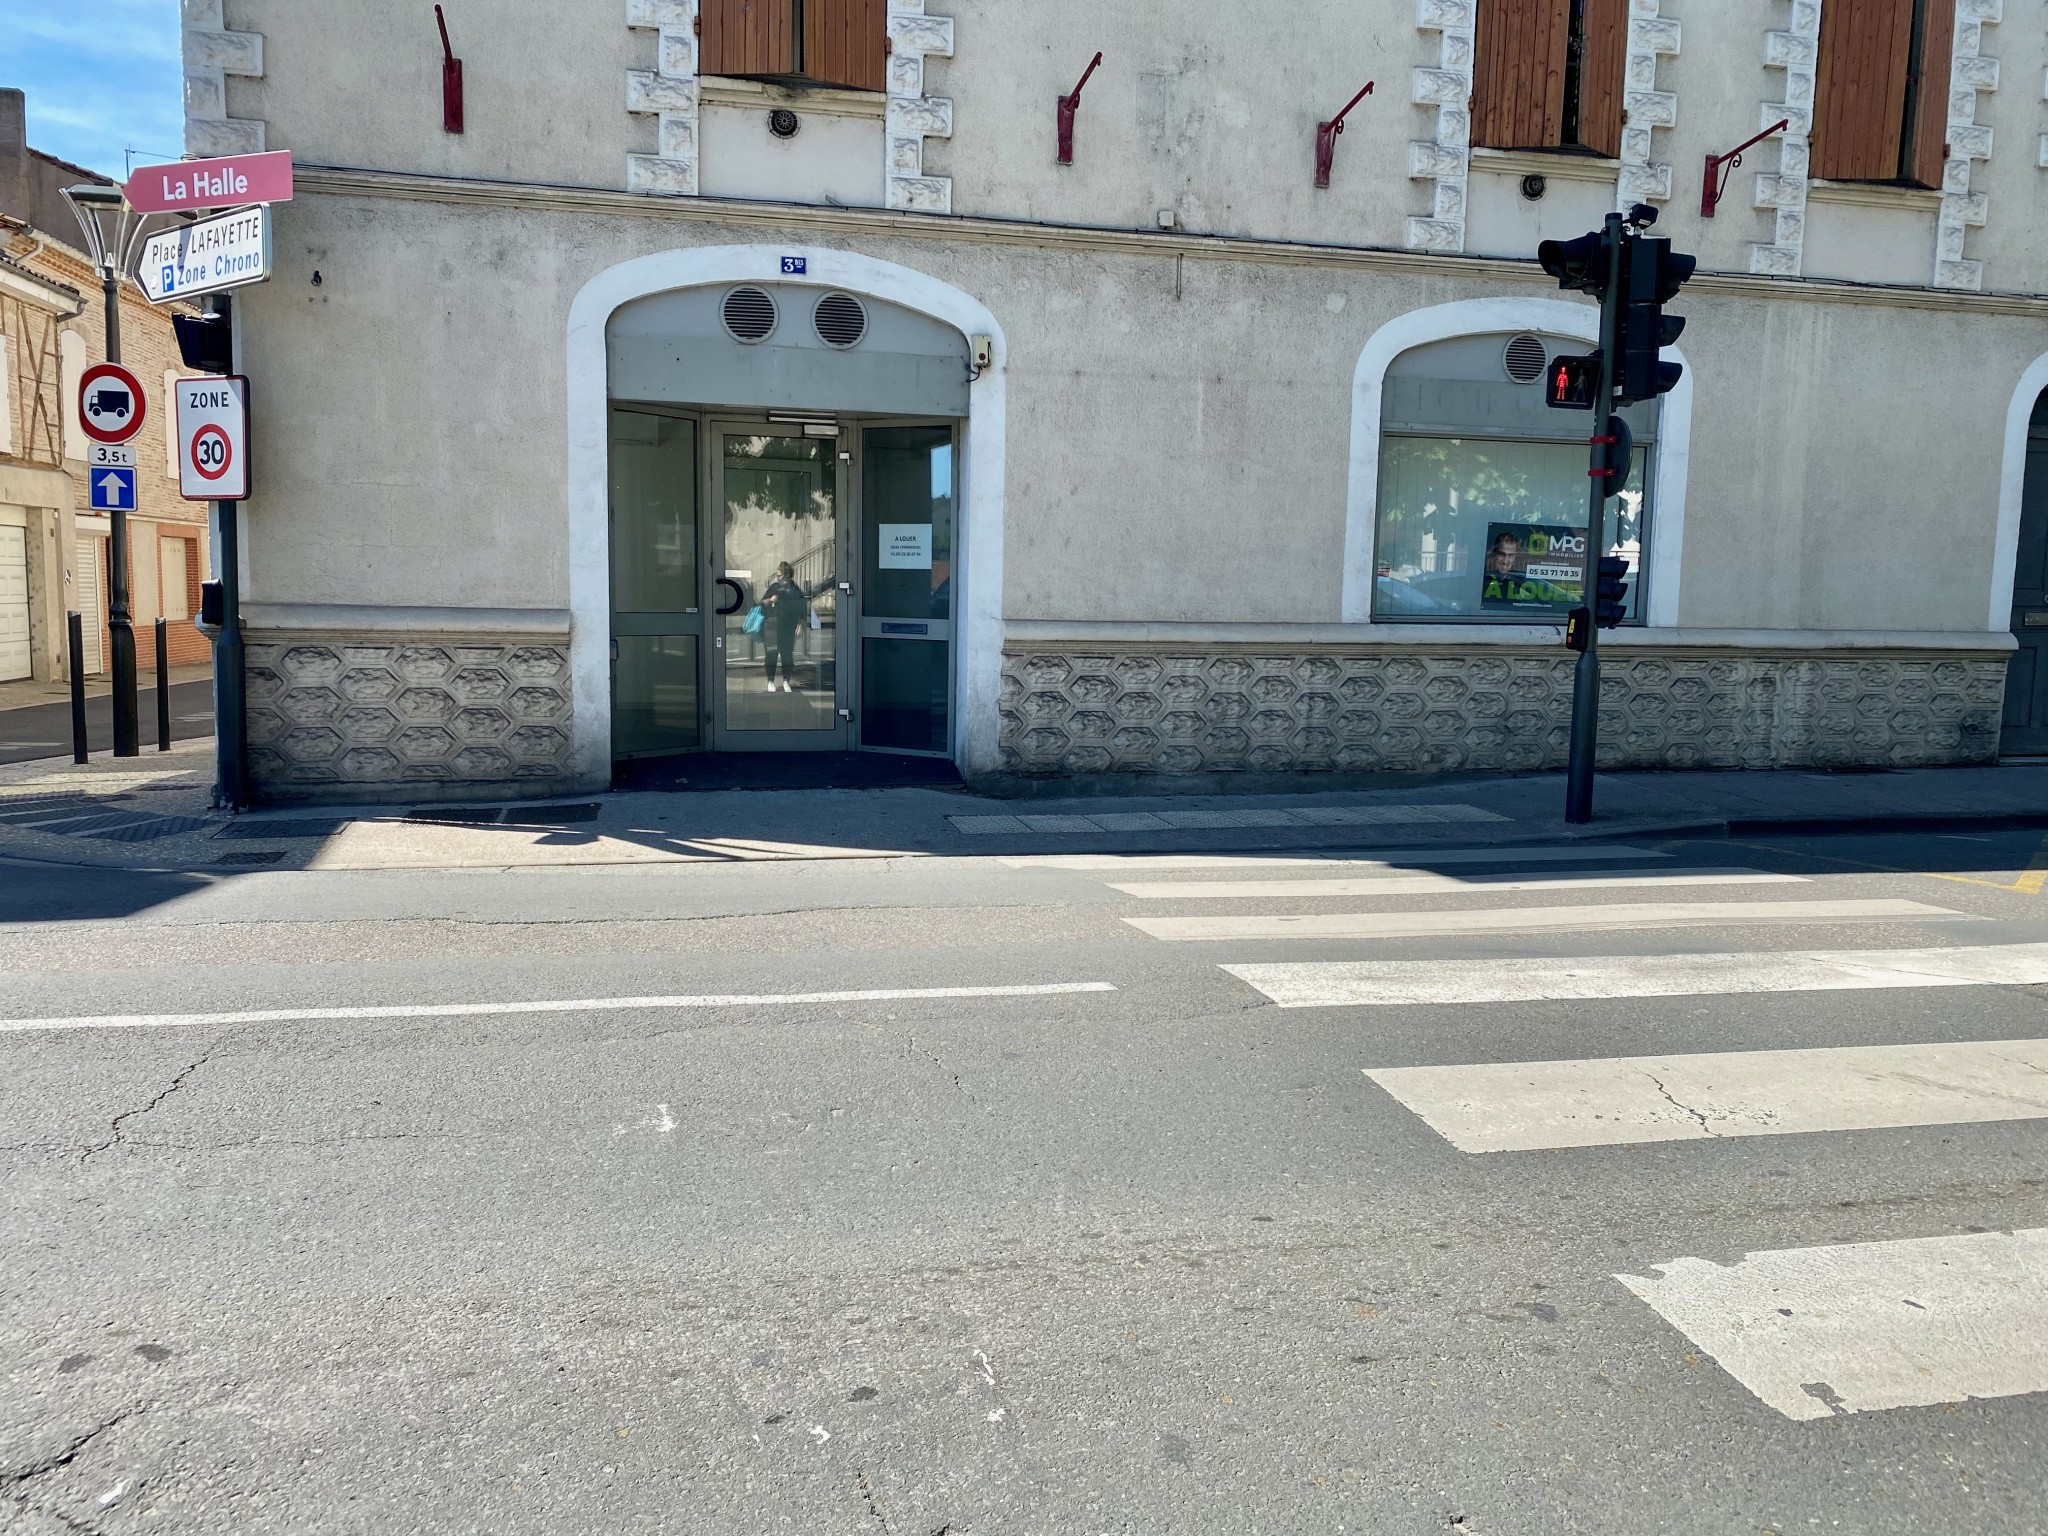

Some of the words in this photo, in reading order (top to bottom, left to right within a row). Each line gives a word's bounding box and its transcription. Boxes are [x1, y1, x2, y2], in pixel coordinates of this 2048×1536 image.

[162, 175, 187, 201] La
[193, 167, 248, 198] Halle
[152, 241, 183, 264] Place
[191, 216, 259, 254] LAFAYETTE
[178, 265, 206, 286] Zone
[215, 251, 260, 276] Chrono
[783, 258, 795, 272] 3
[190, 391, 229, 408] ZONE
[97, 447, 120, 464] 3,5
[122, 451, 127, 463] t
[199, 439, 225, 465] 30
[1549, 535, 1585, 552] MPG
[1484, 574, 1503, 599] À
